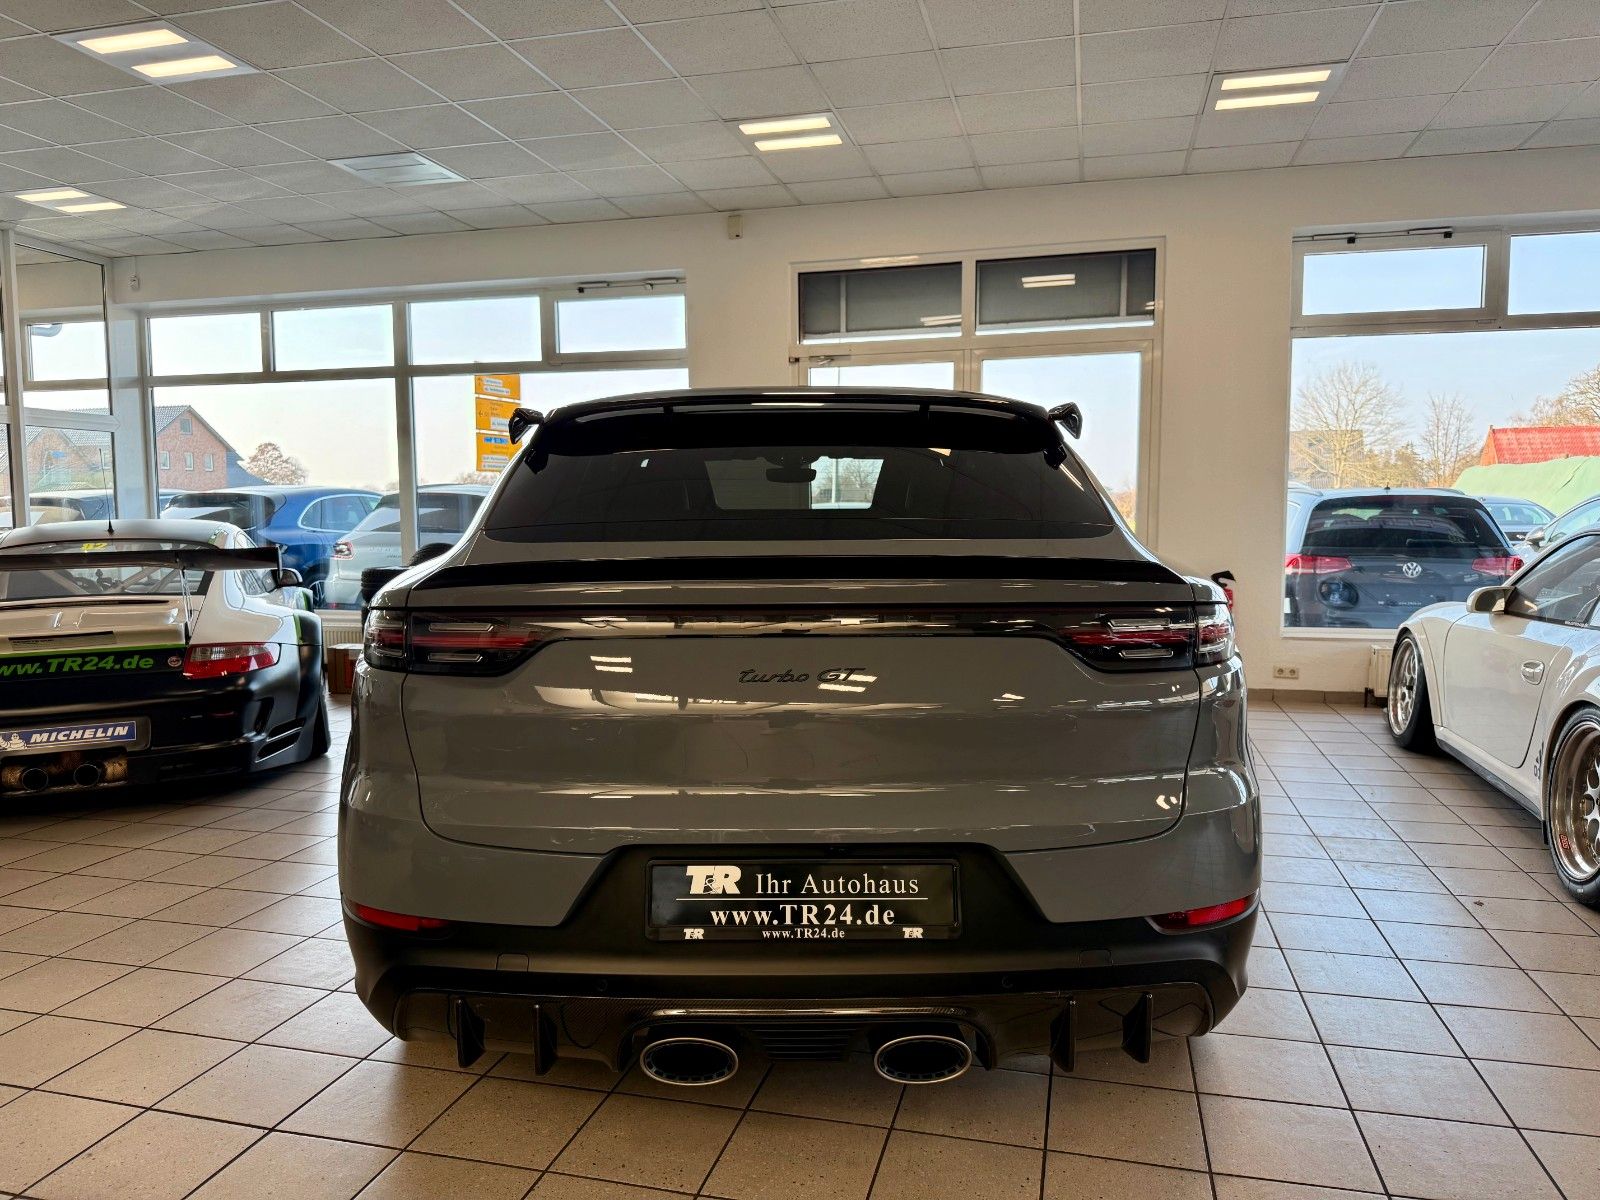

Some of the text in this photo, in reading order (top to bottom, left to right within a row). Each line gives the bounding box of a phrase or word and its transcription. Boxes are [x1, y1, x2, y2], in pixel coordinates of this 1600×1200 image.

[738, 667, 866, 683] turbo GT
[30, 726, 129, 744] MICHELIN
[755, 873, 792, 894] Ihr
[801, 873, 920, 895] Autohaus
[710, 904, 896, 926] www.TR24.de
[762, 928, 846, 939] www.TR24.de
